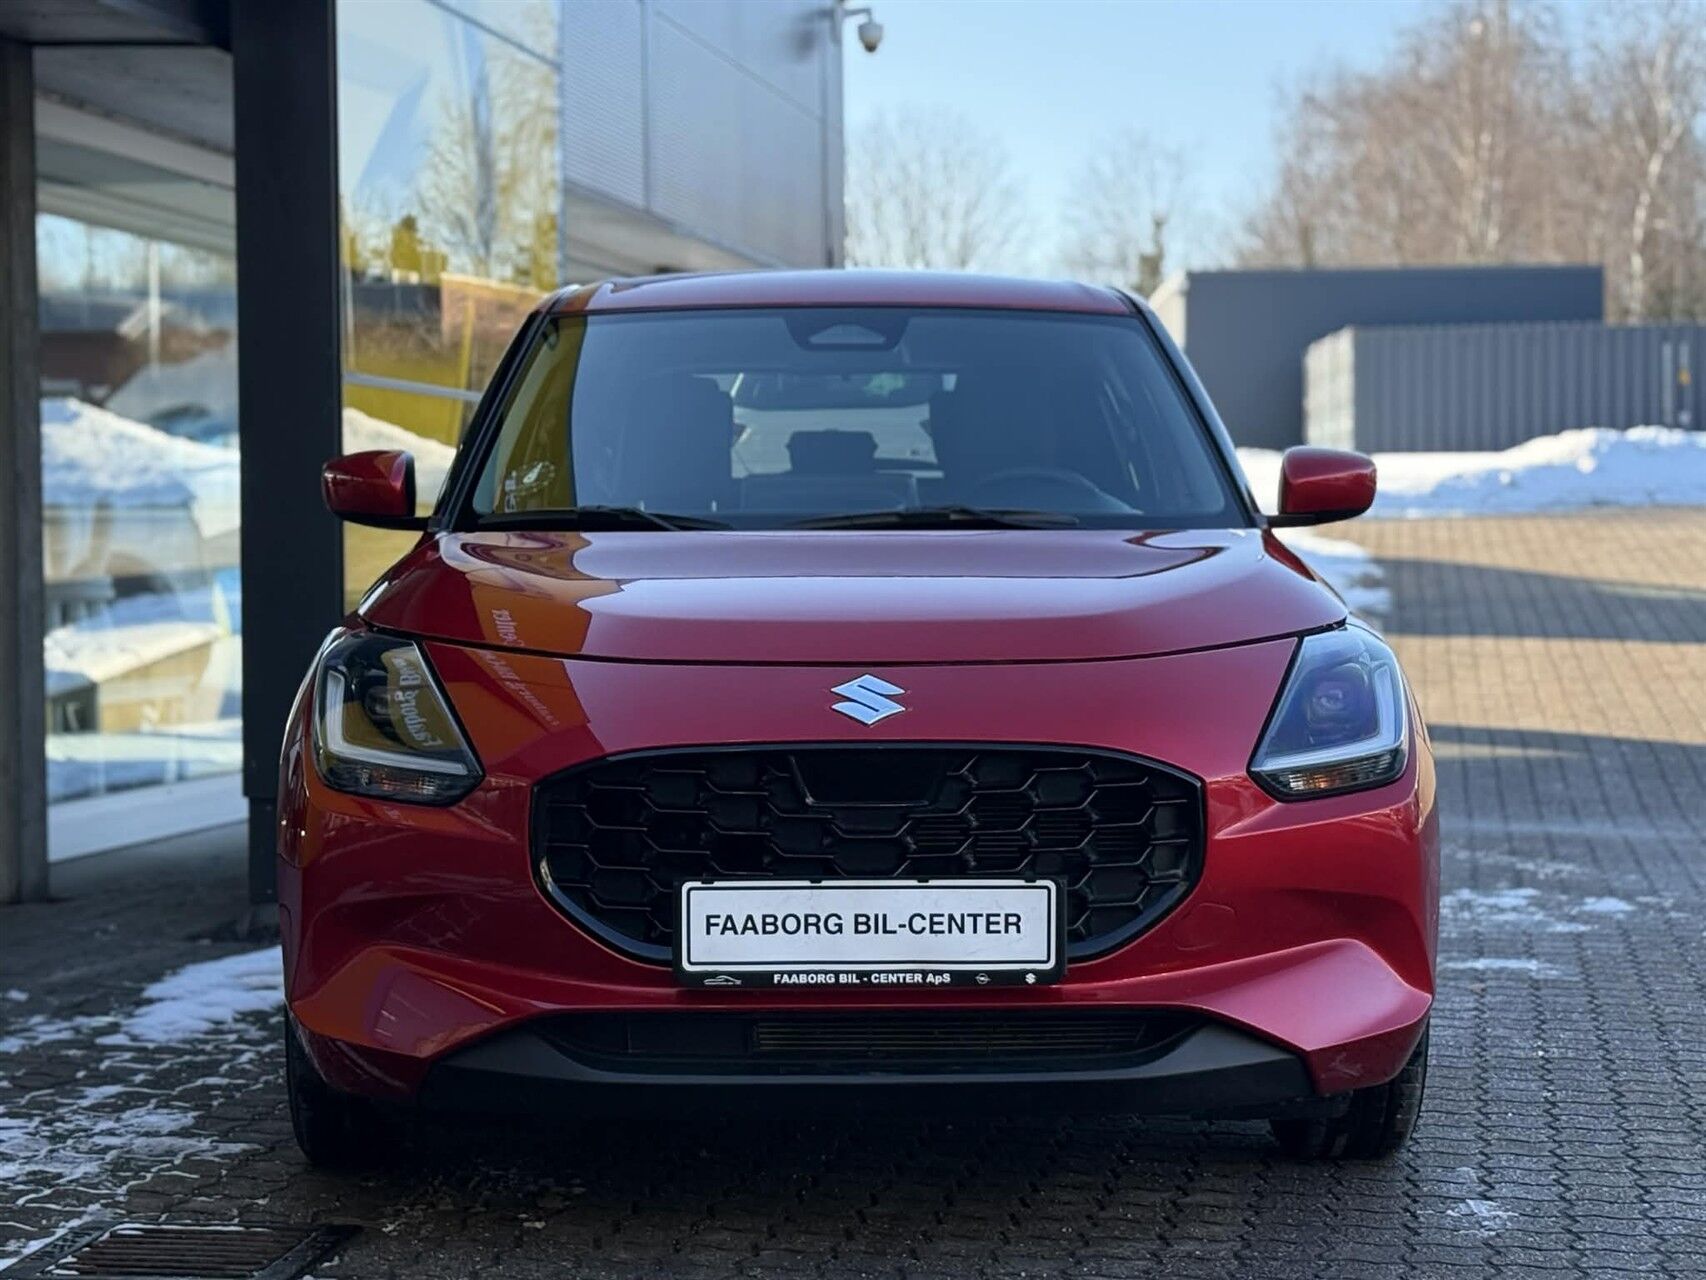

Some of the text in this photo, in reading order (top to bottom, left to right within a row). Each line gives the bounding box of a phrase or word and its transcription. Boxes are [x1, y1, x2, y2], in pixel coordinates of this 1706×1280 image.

[705, 912, 1022, 936] FAABORG BIL-CENTER
[773, 973, 836, 984] FAABORG
[838, 973, 861, 984] BIL
[870, 973, 923, 984] CENTER
[925, 973, 951, 985] ApS
